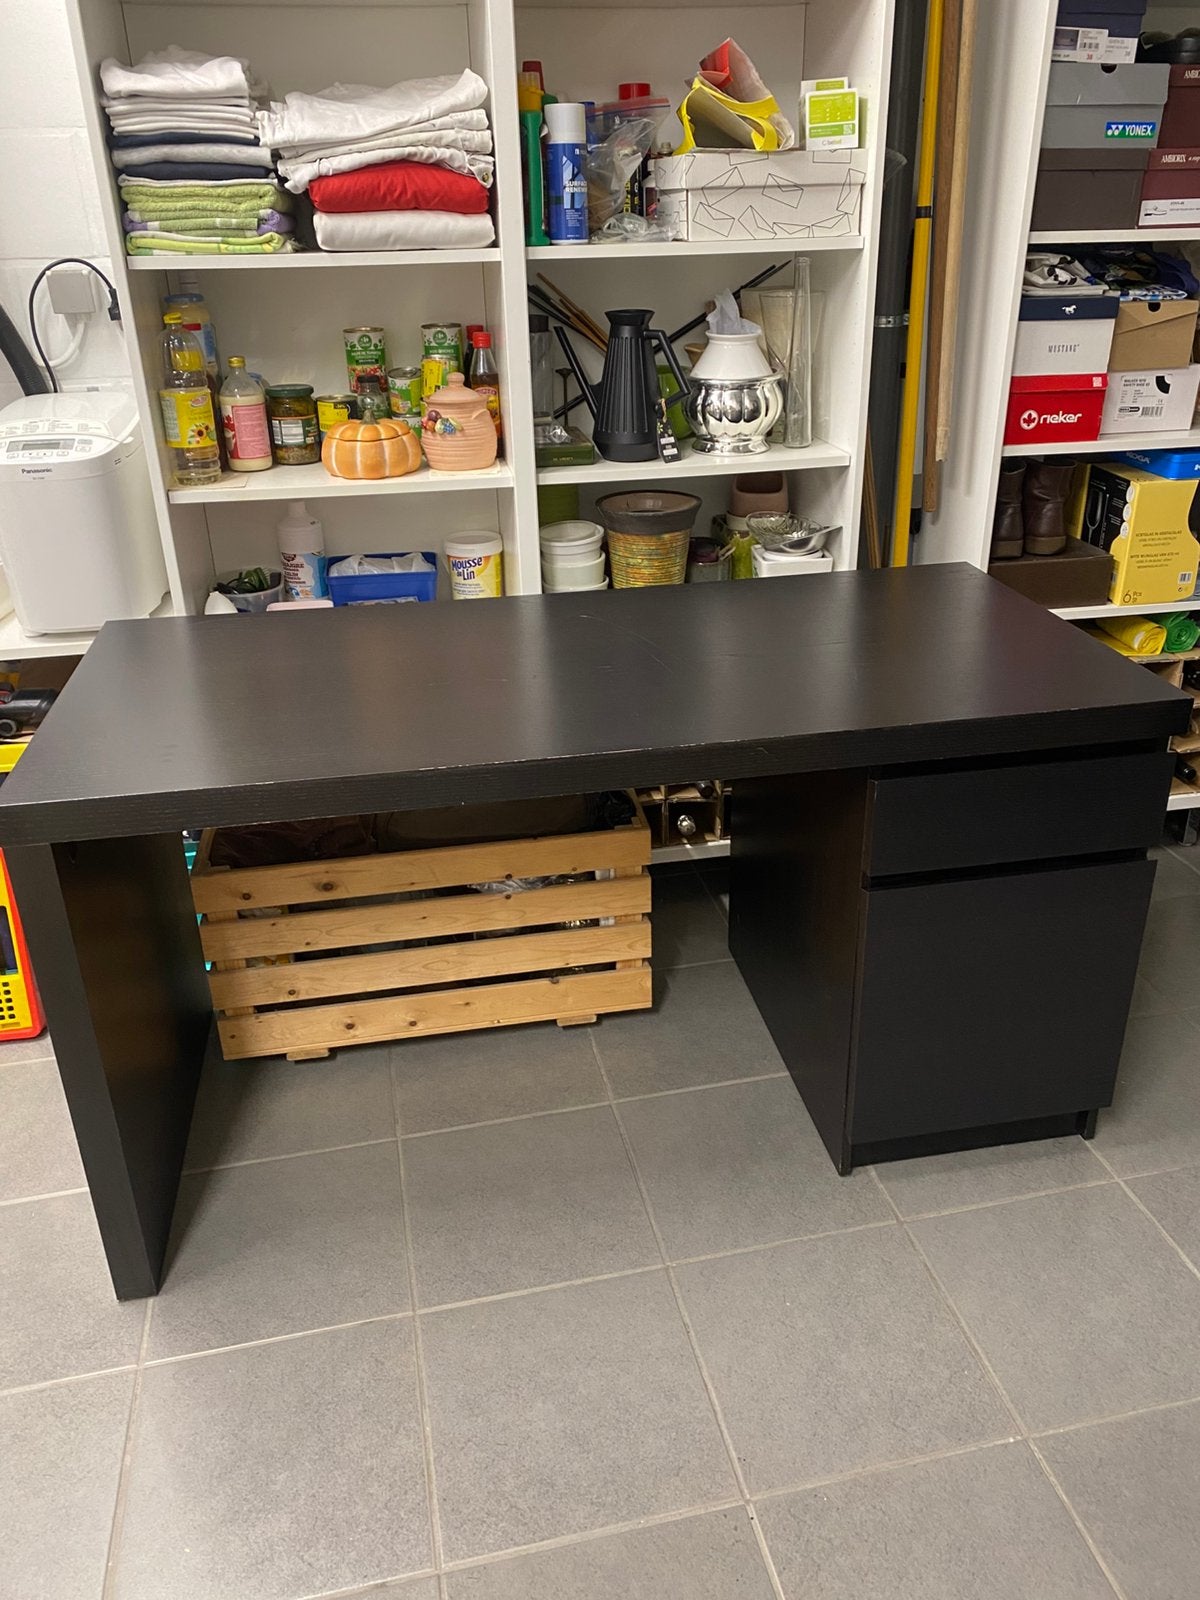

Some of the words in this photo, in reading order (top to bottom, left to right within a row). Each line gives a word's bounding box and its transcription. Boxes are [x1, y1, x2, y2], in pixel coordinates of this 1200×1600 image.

[1124, 125, 1153, 136] YONEX
[1048, 344, 1078, 353] MUSTANG
[1040, 411, 1082, 424] rieker
[452, 557, 482, 571] Mousse
[462, 569, 475, 580] Lin
[1122, 590, 1132, 604] 6
